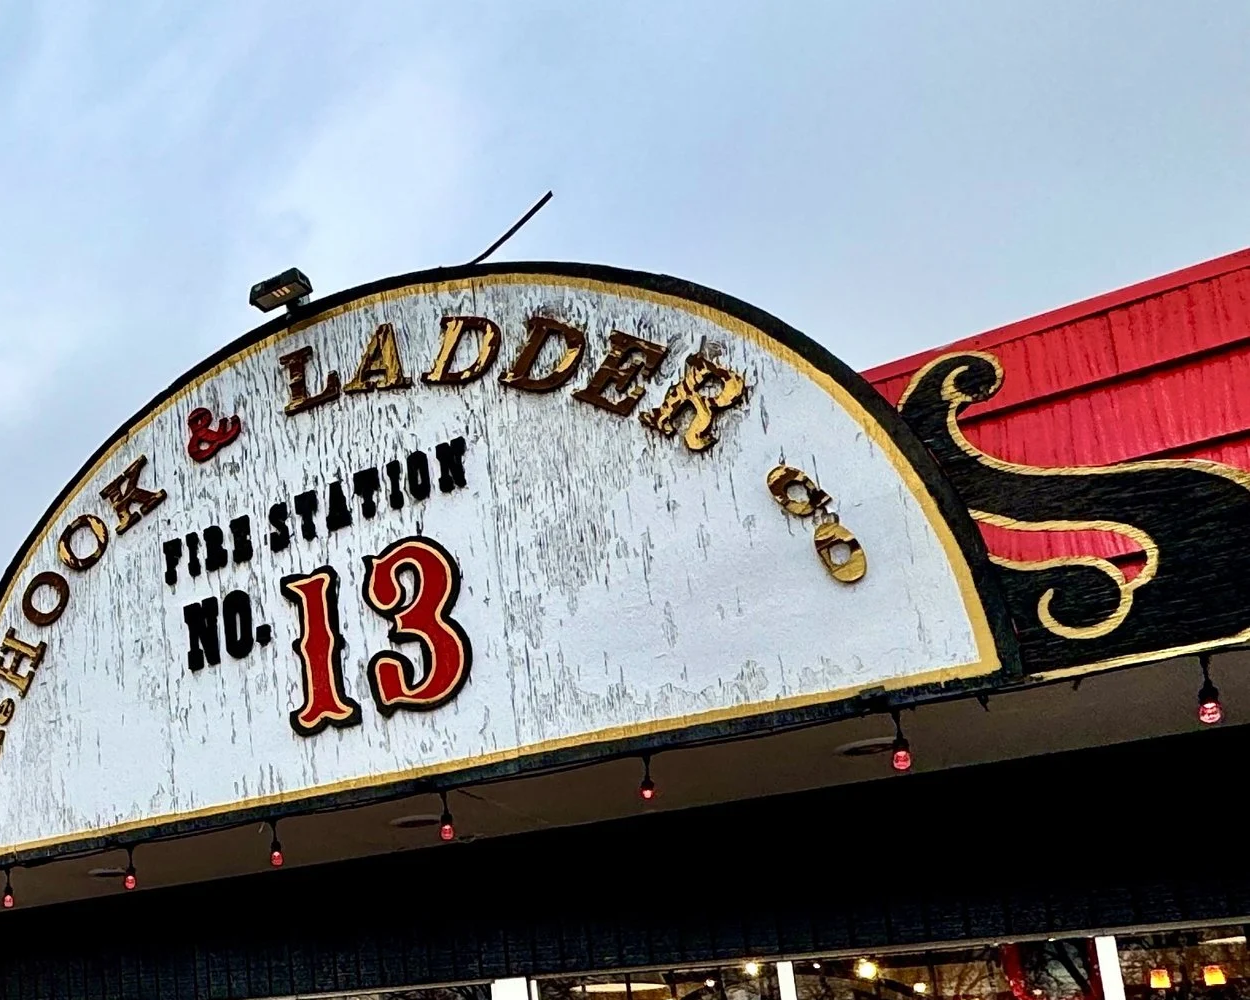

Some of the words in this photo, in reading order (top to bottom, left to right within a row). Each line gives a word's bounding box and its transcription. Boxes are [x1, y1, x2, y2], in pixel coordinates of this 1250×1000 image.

[187, 406, 242, 462] &
[279, 315, 747, 453] LADDER
[162, 514, 254, 586] FIRE
[268, 436, 467, 552] STATION
[183, 589, 272, 672] NO.
[280, 535, 473, 738] 13
